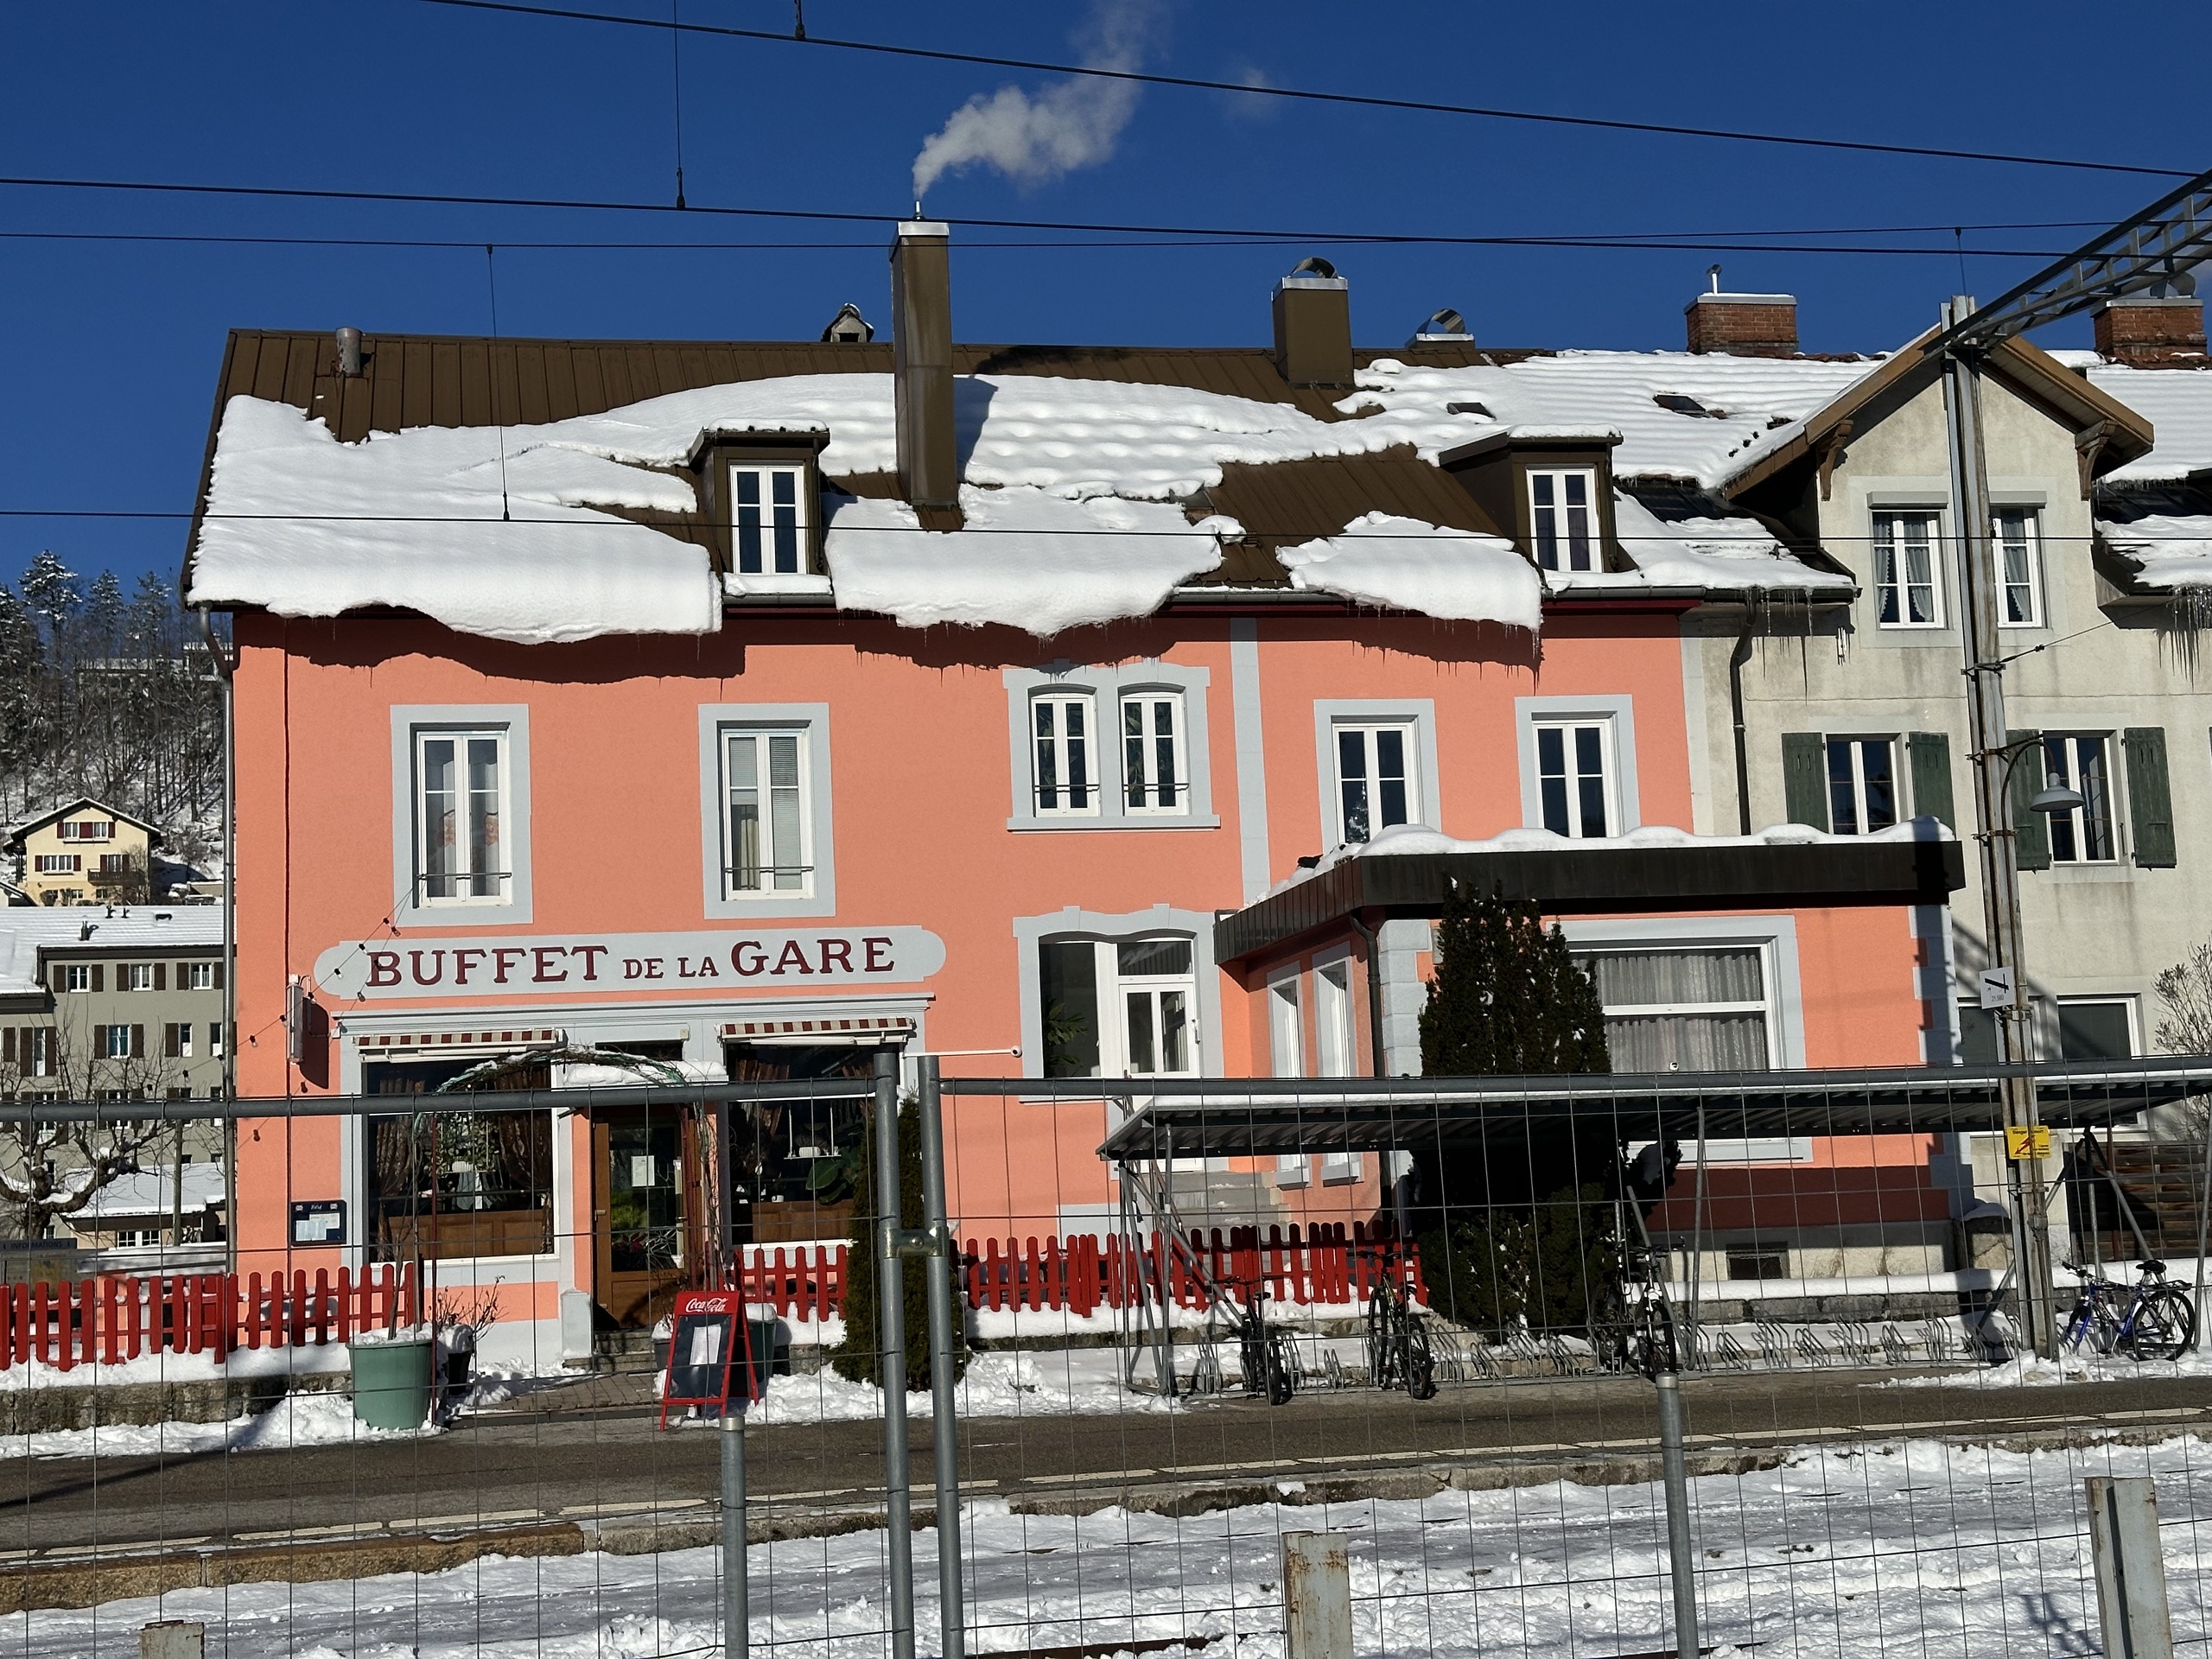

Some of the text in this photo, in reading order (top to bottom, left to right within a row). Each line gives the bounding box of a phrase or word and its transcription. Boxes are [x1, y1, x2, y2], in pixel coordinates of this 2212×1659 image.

[365, 937, 894, 987] BUFFET DE LA GARE
